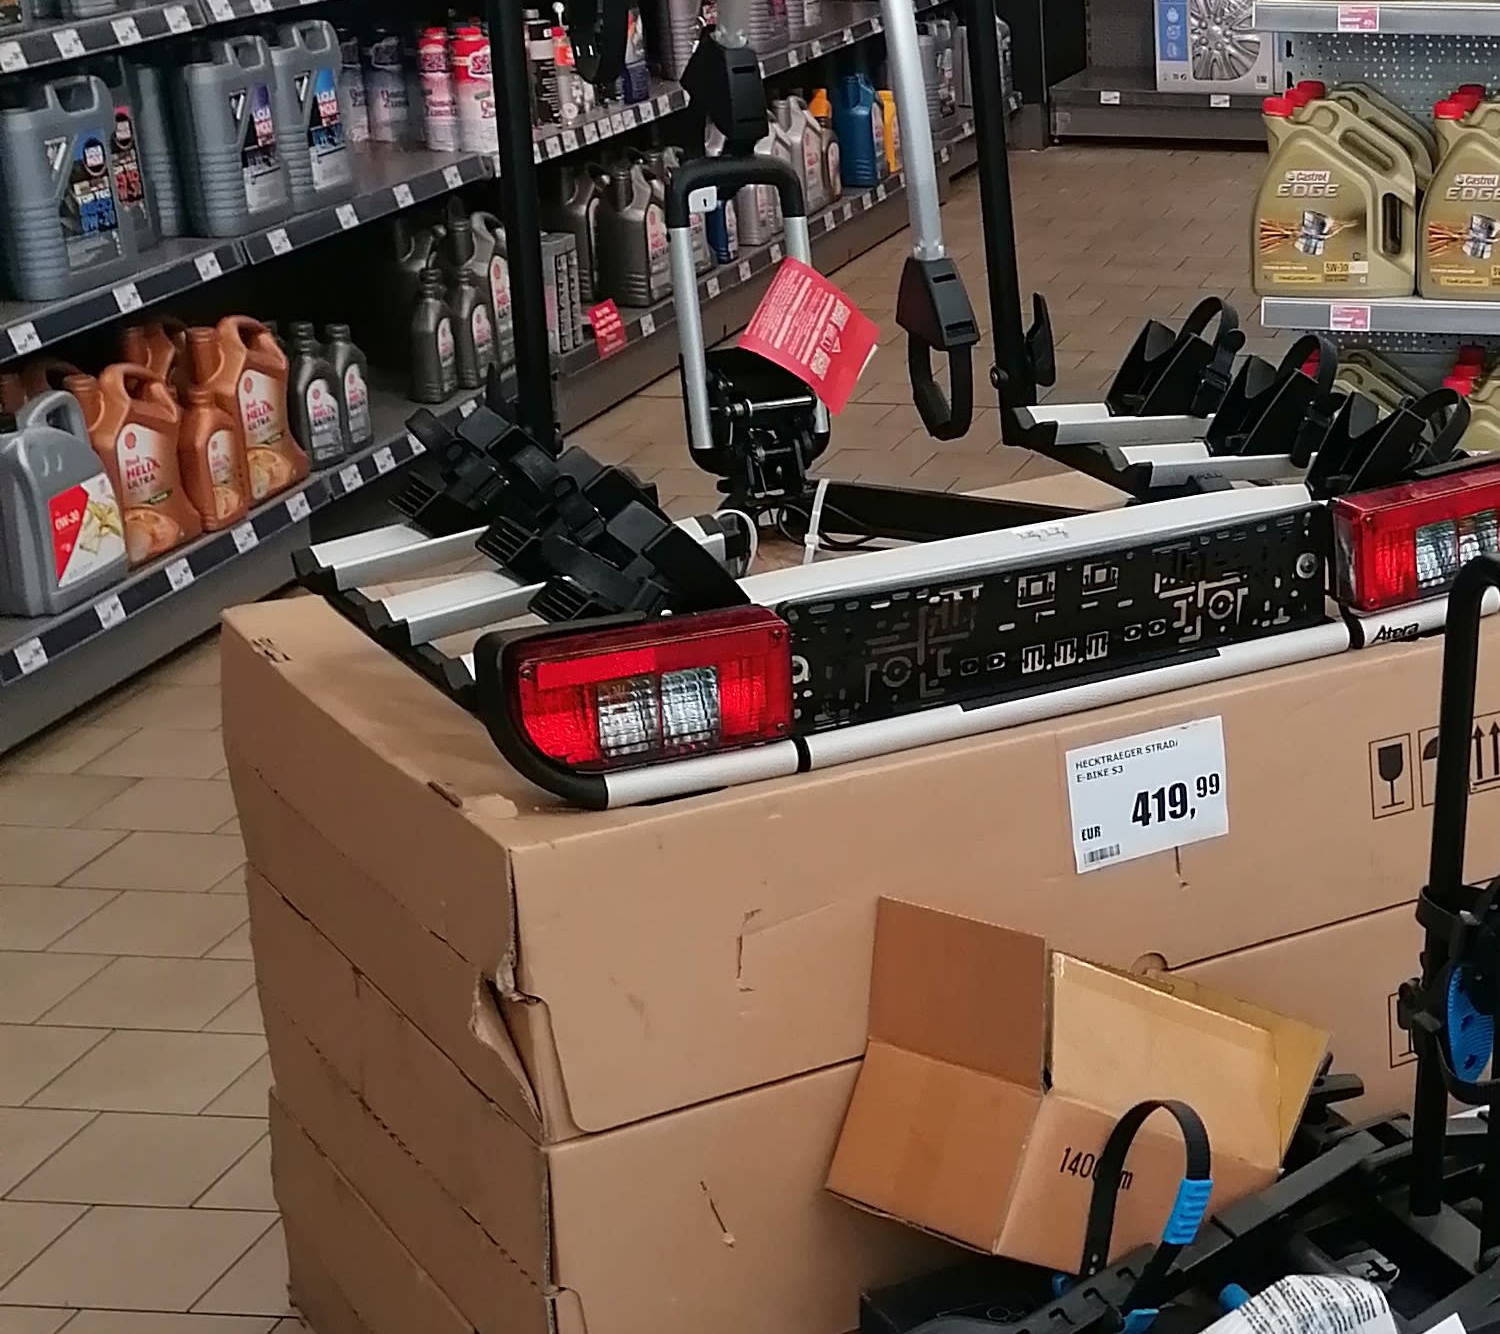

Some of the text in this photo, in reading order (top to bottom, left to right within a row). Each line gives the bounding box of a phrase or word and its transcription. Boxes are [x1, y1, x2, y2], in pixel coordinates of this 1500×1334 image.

[1296, 172, 1327, 182] Castrol
[1465, 175, 1496, 186] Castrol
[1277, 184, 1340, 198] EDGE
[1371, 622, 1419, 643] Atera
[1075, 747, 1143, 770] HECKTRAEGER
[1077, 768, 1109, 783] E-BIKE
[1081, 825, 1101, 842] EUR
